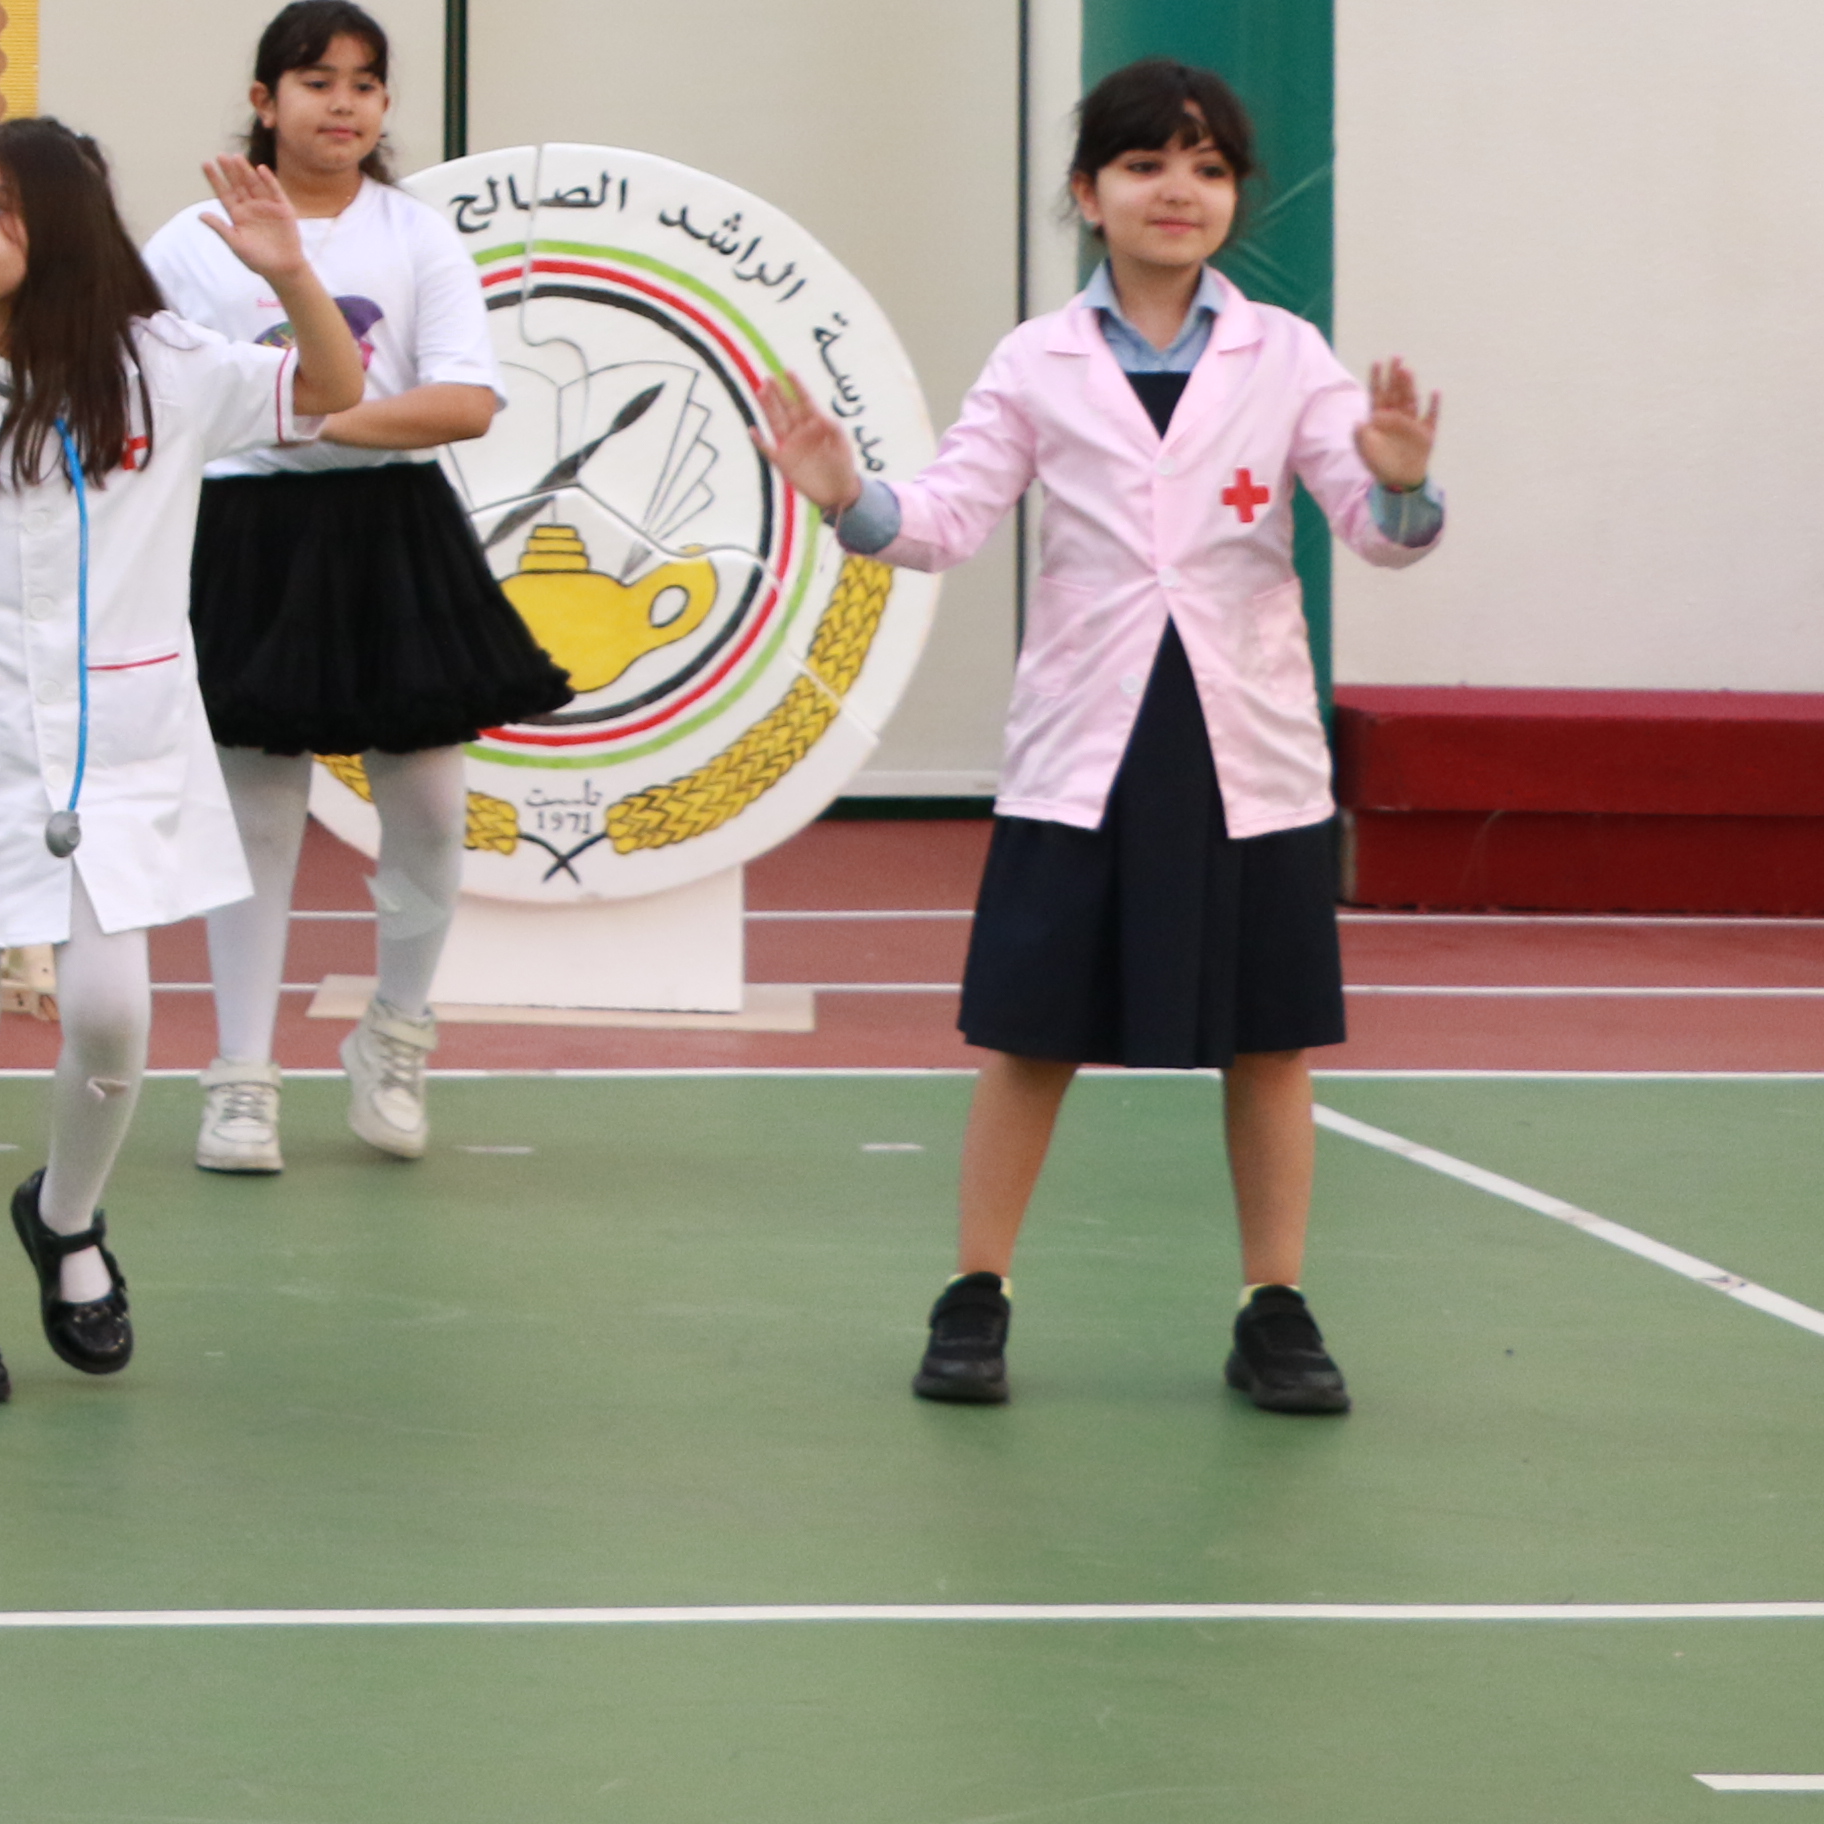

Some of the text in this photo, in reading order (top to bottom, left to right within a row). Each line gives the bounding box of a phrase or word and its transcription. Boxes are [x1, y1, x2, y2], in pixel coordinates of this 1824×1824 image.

[448, 169, 885, 473] مدرسة الراشد الصالح
[536, 811, 592, 835] 1971
